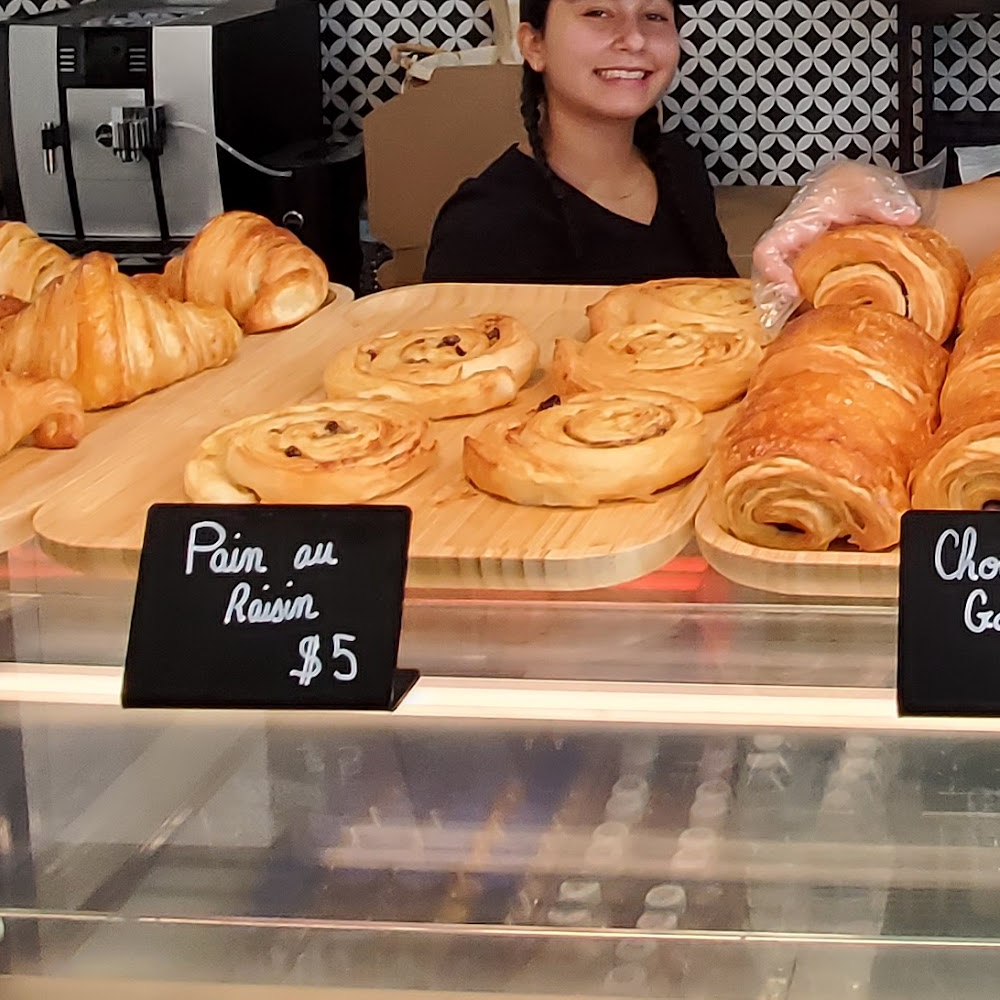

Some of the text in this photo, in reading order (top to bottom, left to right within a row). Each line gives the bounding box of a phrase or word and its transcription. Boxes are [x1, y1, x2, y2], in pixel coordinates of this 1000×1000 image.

[185, 521, 338, 575] Pain au
[223, 580, 320, 625] Raisin
